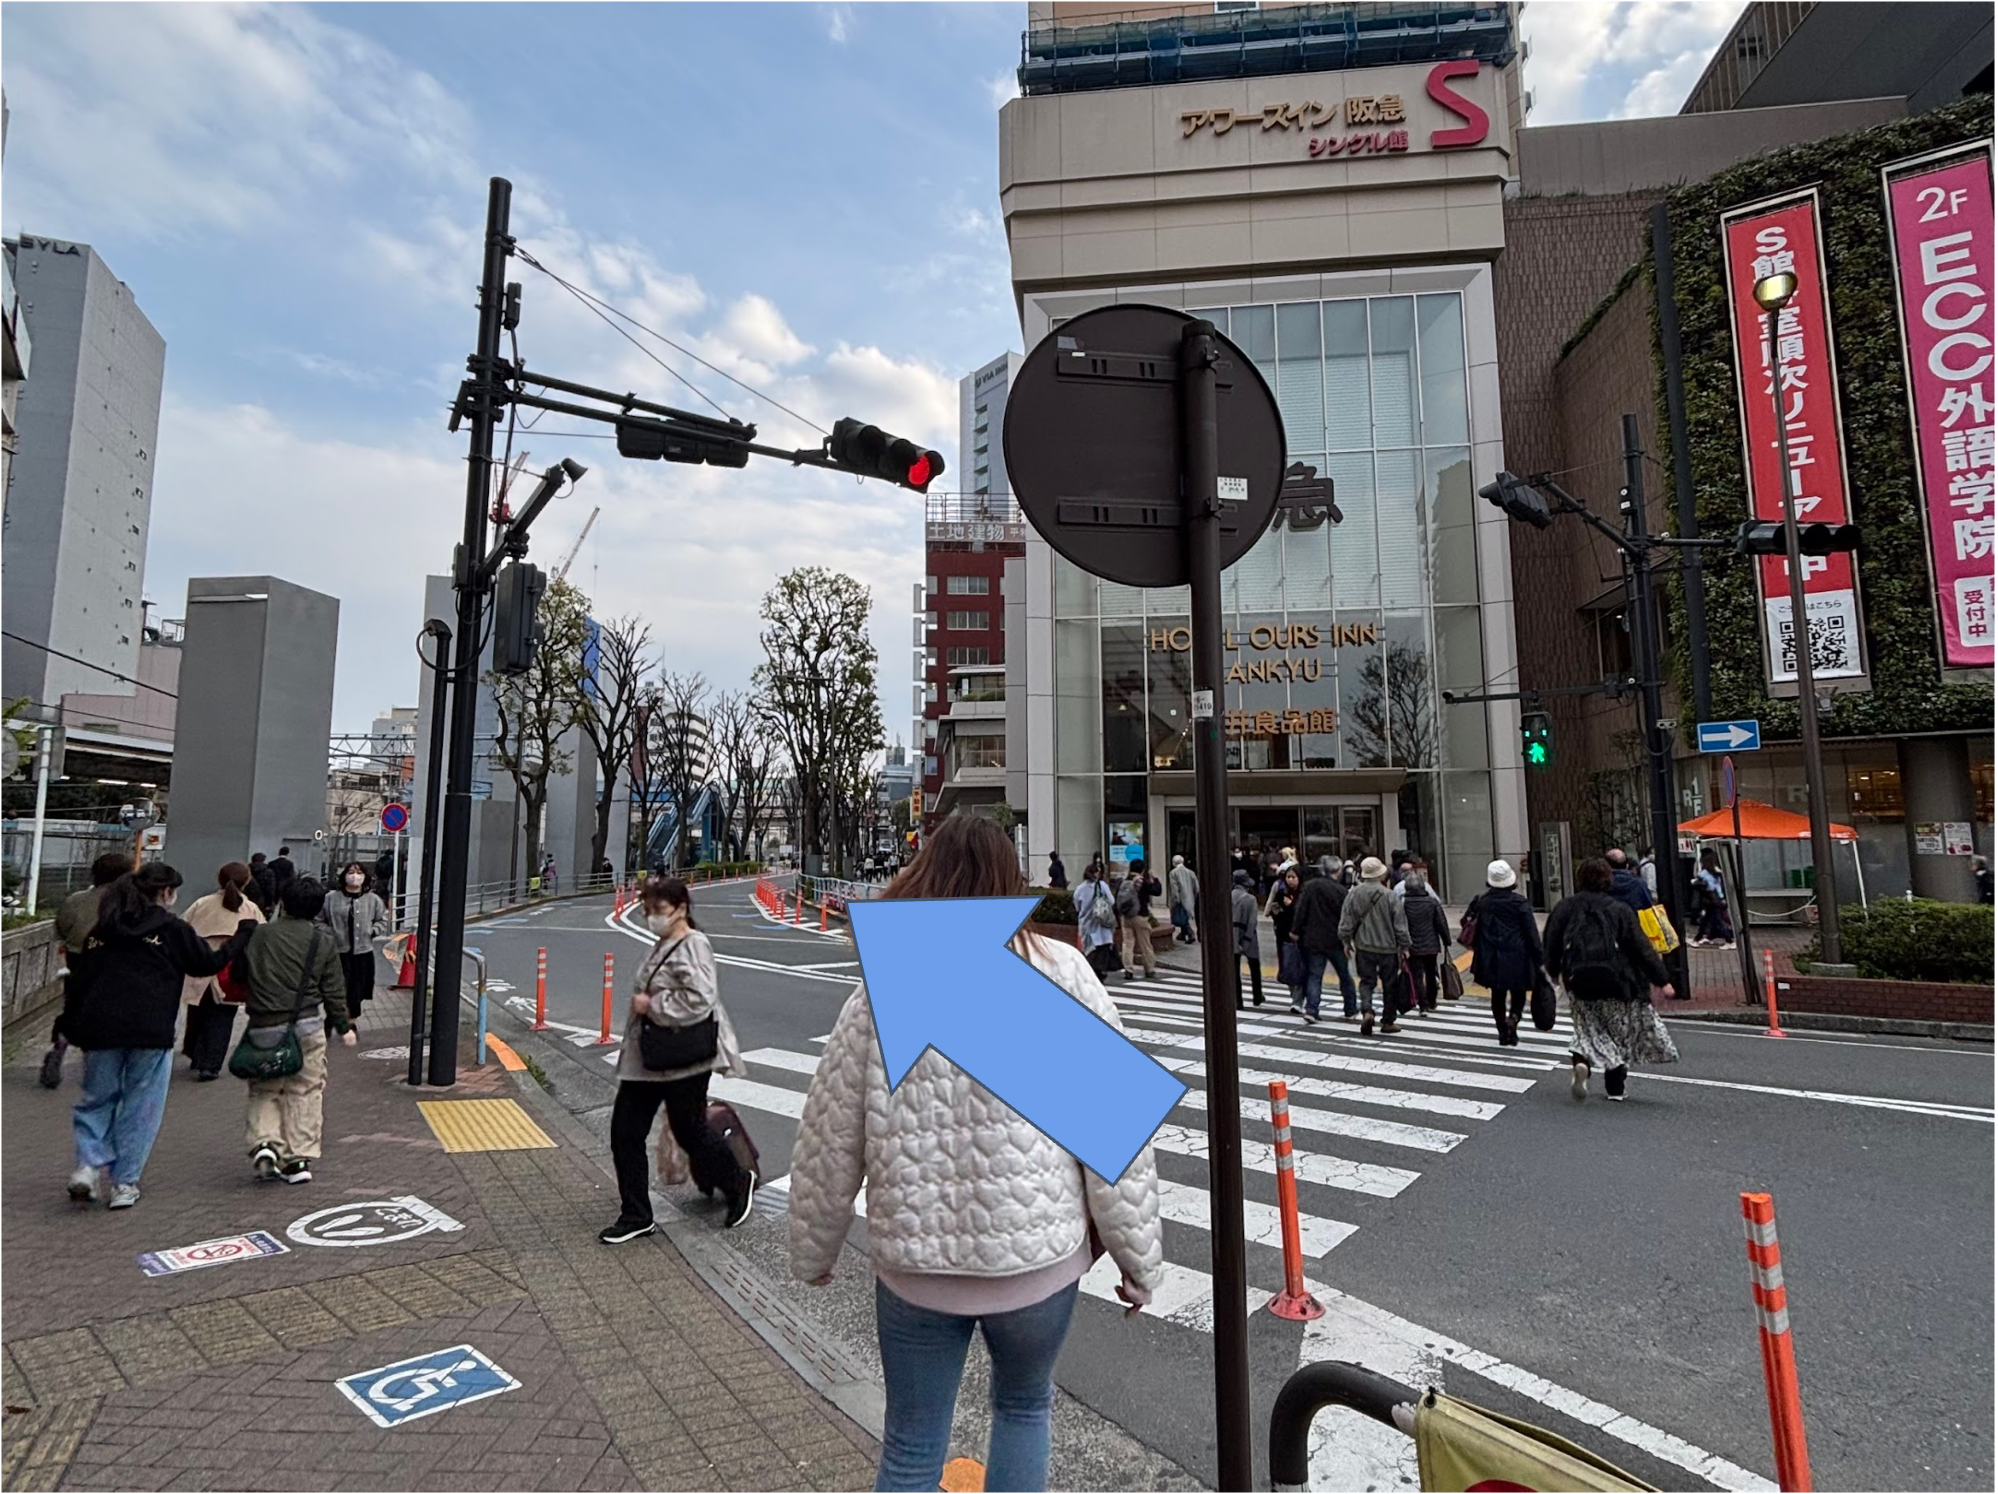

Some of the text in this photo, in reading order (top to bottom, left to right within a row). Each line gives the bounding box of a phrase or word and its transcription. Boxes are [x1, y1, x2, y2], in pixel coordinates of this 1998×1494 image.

[1180, 93, 1406, 137] アワーズイン 阪急
[1426, 59, 1490, 149] S
[1309, 130, 1409, 157] シングル館
[1916, 187, 1968, 223] 2F
[1751, 226, 1828, 581] S館室順次リニューア中
[1271, 461, 1343, 532] 急
[928, 523, 1005, 541] 土地建物
[1779, 600, 1841, 613] ごはこちら
[1964, 589, 1987, 638] 受付中
[1151, 621, 1378, 650] HOL OURS INN
[1225, 657, 1323, 684] ANKYU
[1225, 707, 1336, 735] 井食品館
